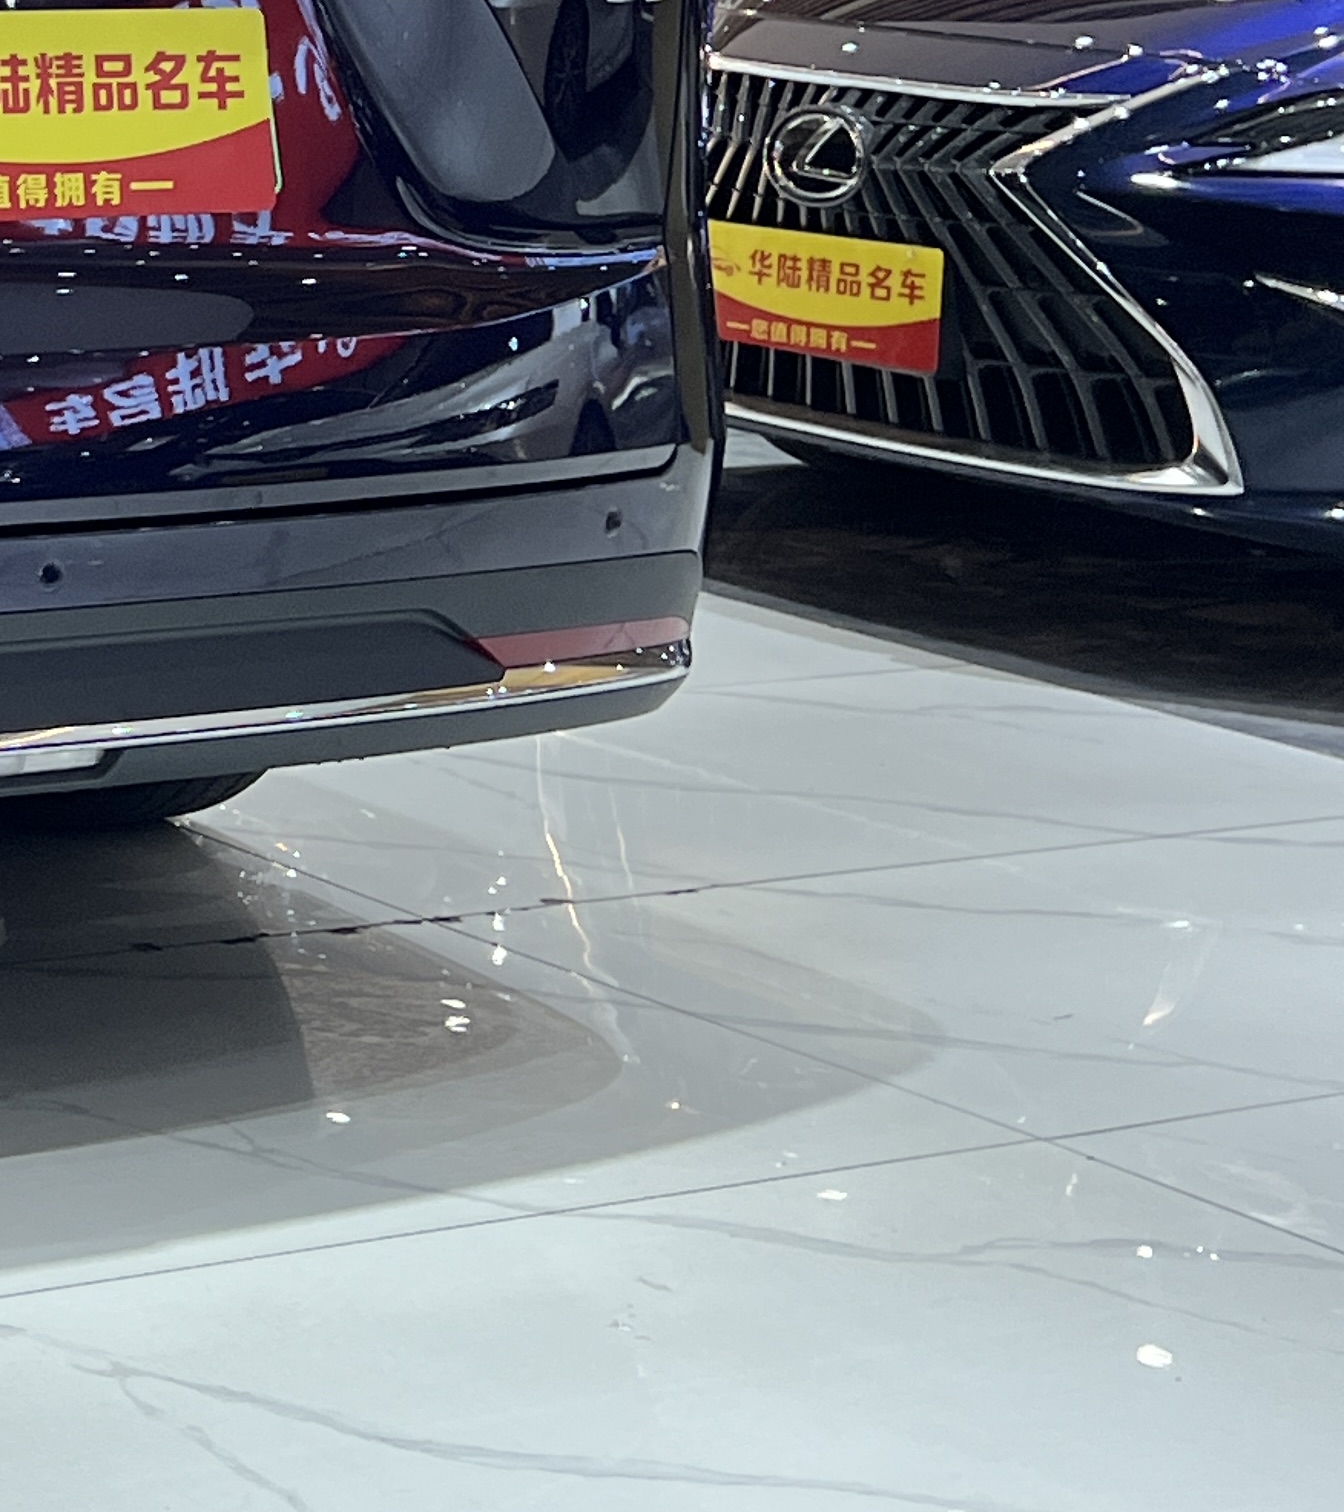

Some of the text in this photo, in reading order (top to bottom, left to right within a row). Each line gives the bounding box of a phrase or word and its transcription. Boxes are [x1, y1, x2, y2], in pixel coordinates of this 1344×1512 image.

[748, 249, 927, 306] 华陆精品名车
